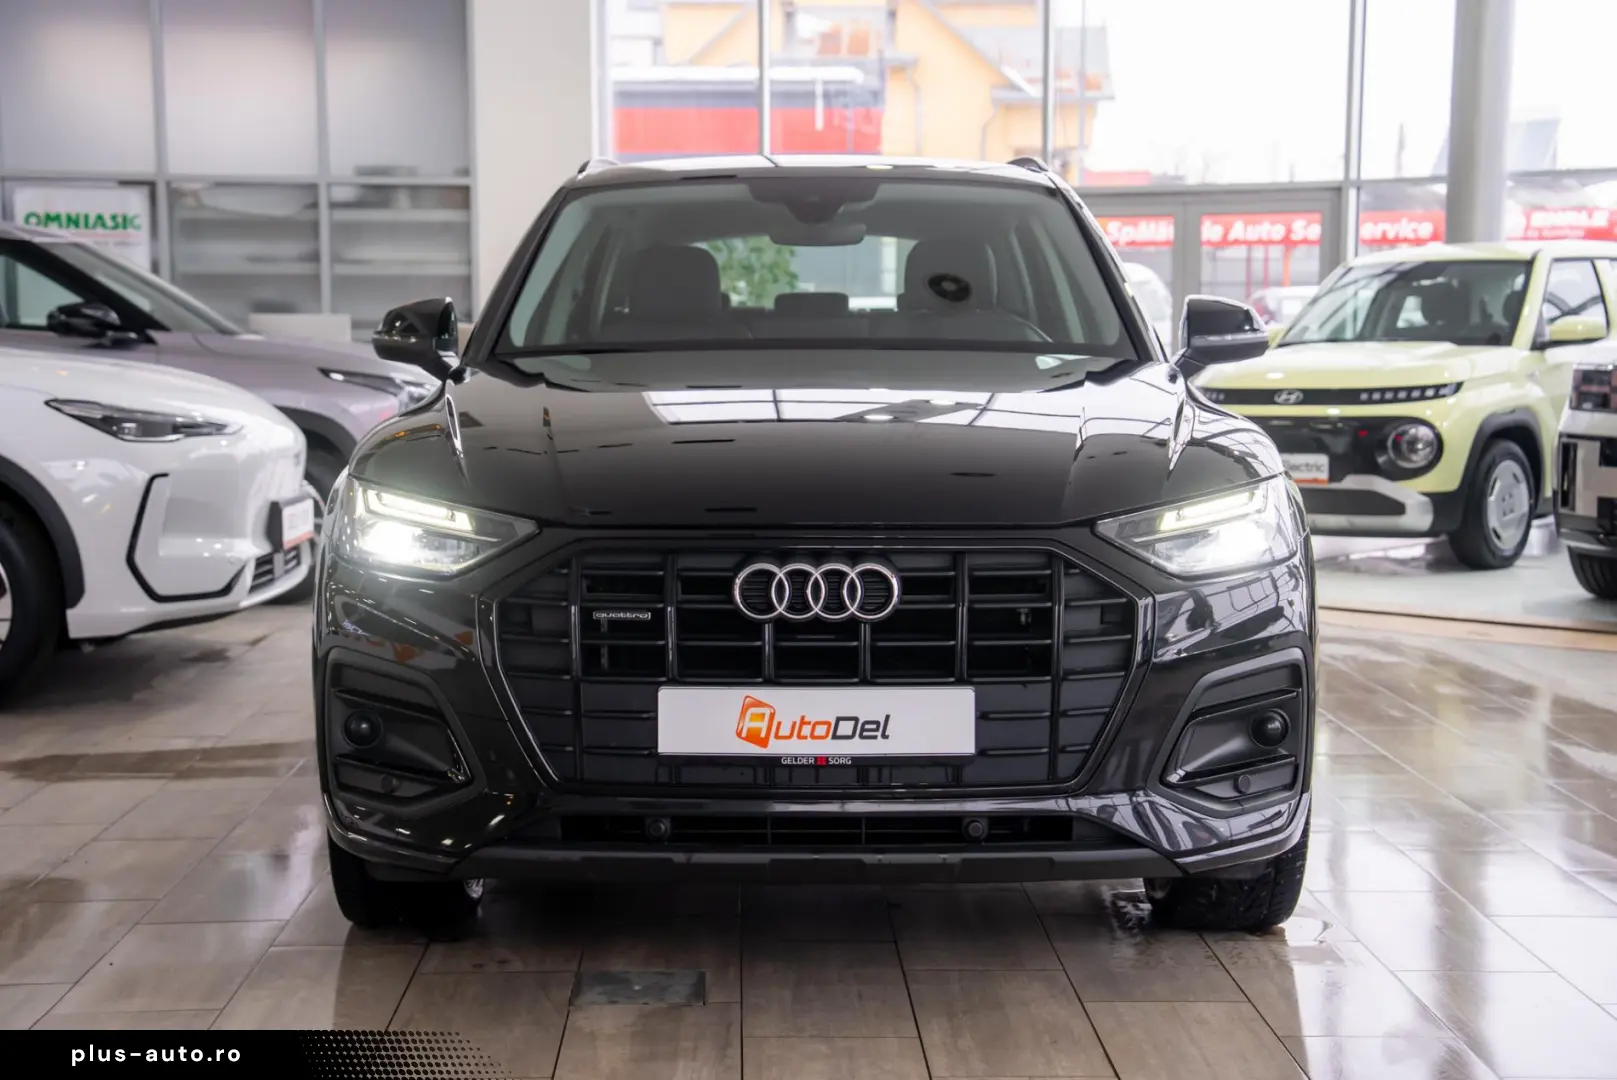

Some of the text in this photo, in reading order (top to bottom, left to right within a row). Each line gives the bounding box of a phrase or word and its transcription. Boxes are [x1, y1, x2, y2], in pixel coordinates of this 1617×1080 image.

[1228, 220, 1285, 241] Auto
[594, 611, 650, 620] quattro
[739, 704, 890, 742] AutoDel
[781, 756, 852, 765] GELDER SORG
